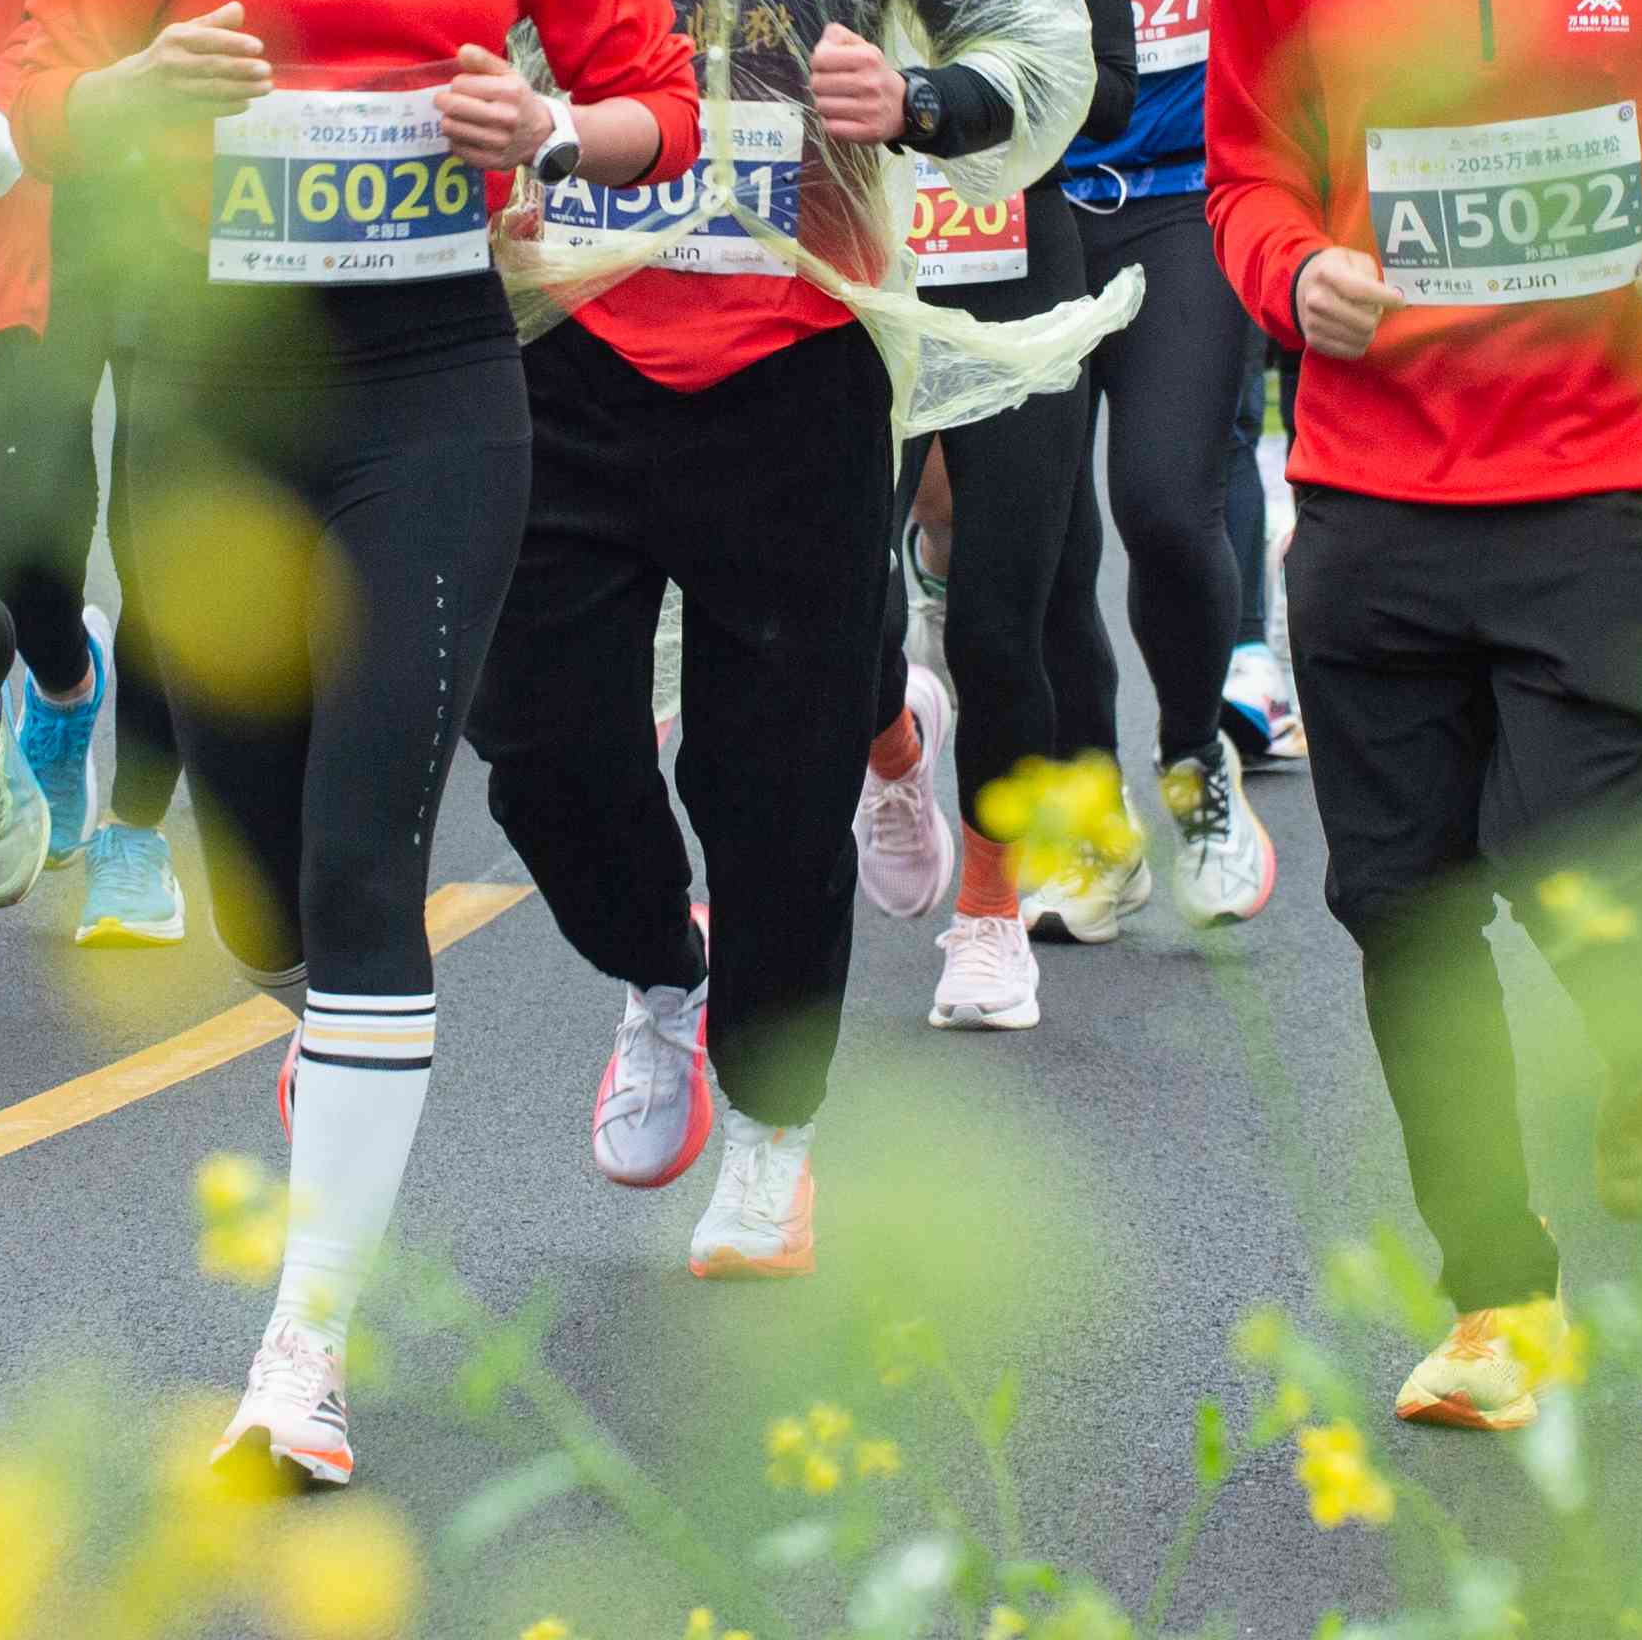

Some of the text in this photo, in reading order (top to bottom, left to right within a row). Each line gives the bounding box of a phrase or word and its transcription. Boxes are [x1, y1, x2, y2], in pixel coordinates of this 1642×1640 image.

[303, 121, 444, 145] ·2025万峰林马
[220, 157, 470, 225] A 6026
[550, 176, 598, 213] A
[907, 189, 1008, 240] 020
[1386, 172, 1630, 254] A 5022
